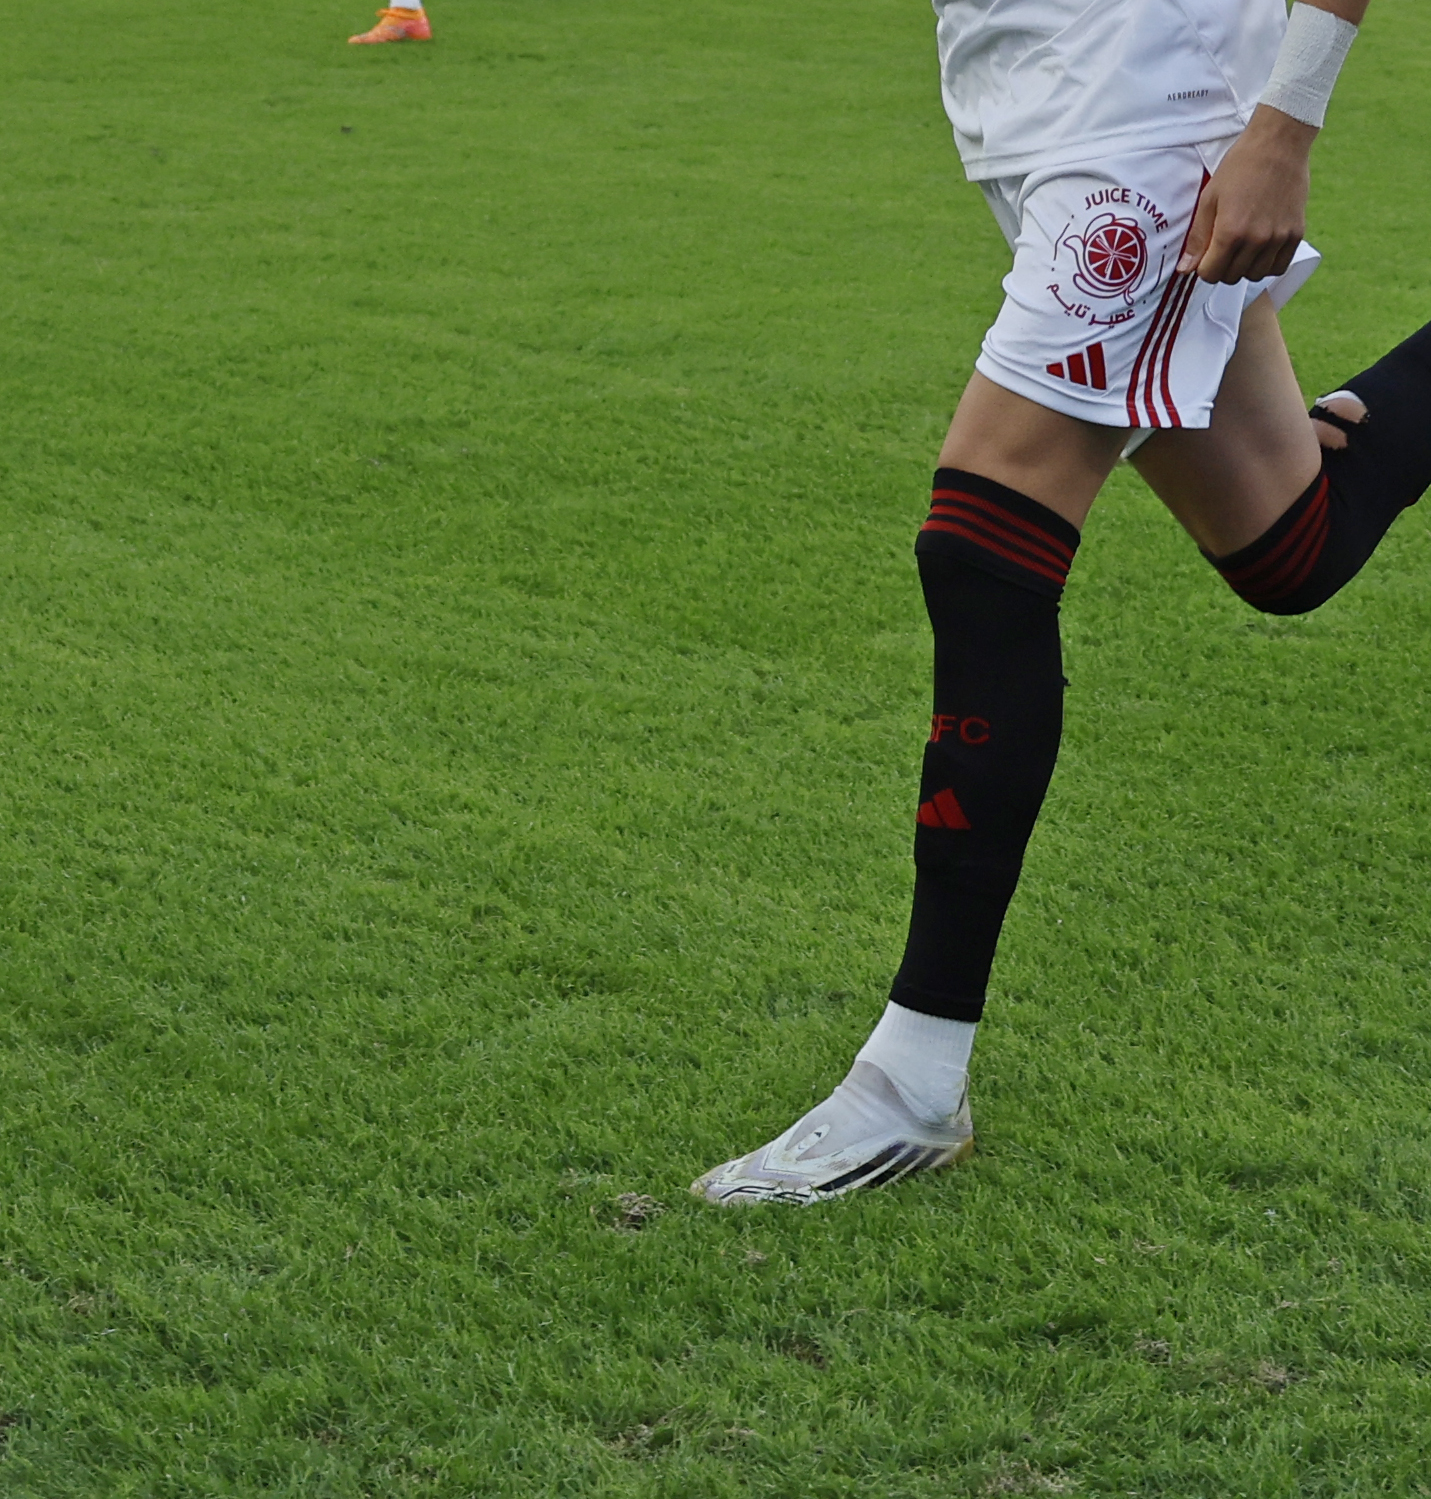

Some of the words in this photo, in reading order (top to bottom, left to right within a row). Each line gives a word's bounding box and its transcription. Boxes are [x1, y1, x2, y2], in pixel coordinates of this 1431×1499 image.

[1167, 88, 1210, 102] AEROREADY
[1084, 187, 1132, 211] JUICE
[1136, 191, 1170, 234] TIME
[1046, 282, 1092, 318] تايم
[1087, 308, 1136, 330] عصير
